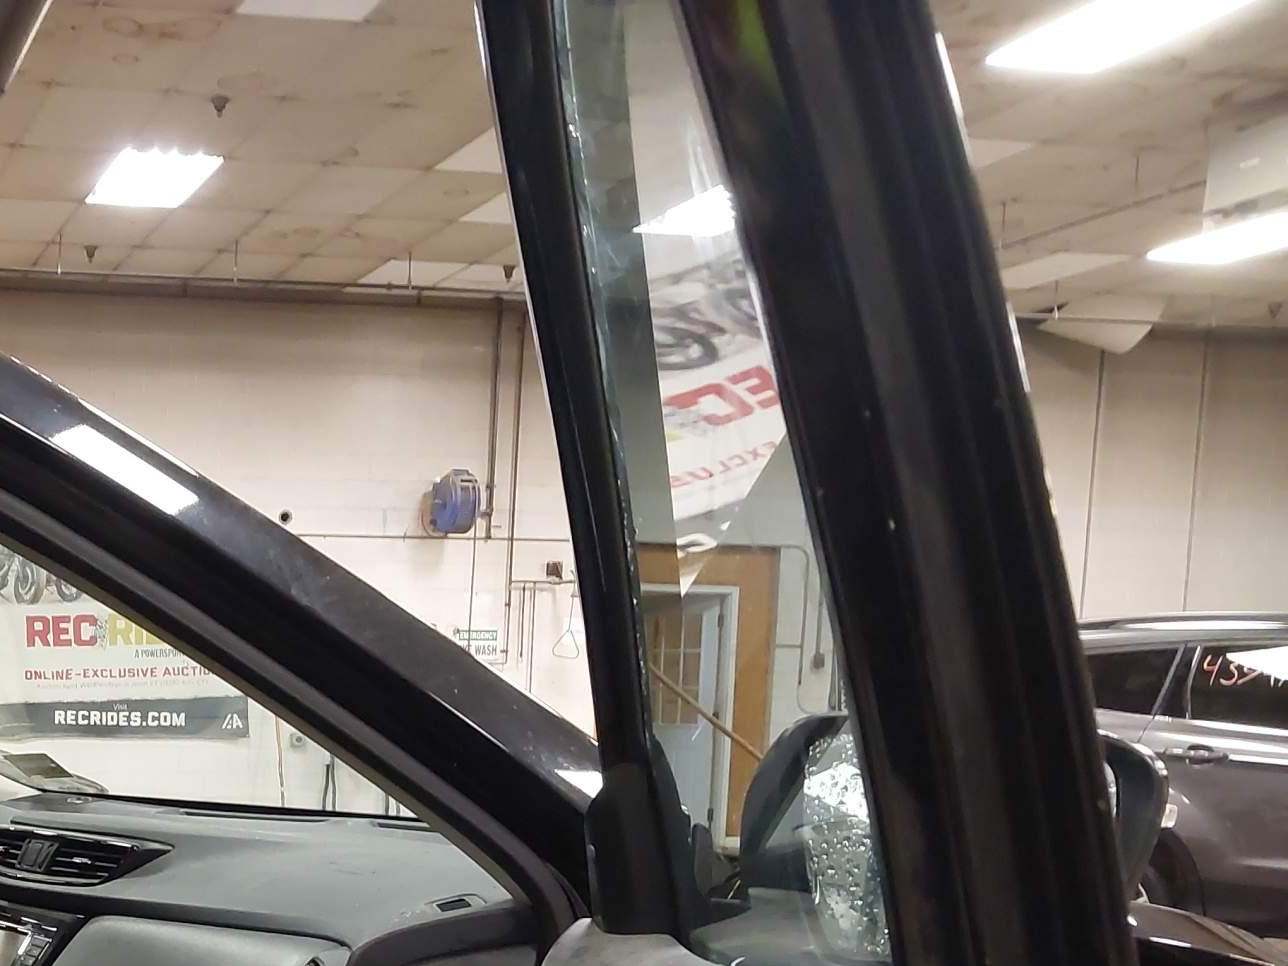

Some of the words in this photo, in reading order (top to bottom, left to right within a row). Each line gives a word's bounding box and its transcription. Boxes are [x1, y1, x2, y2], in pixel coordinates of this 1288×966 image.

[25, 614, 99, 648] REC
[474, 644, 497, 656] WASH
[24, 666, 158, 681] ONLINE-EXCLUSIVE
[54, 709, 186, 727] RECRIDES.COM
